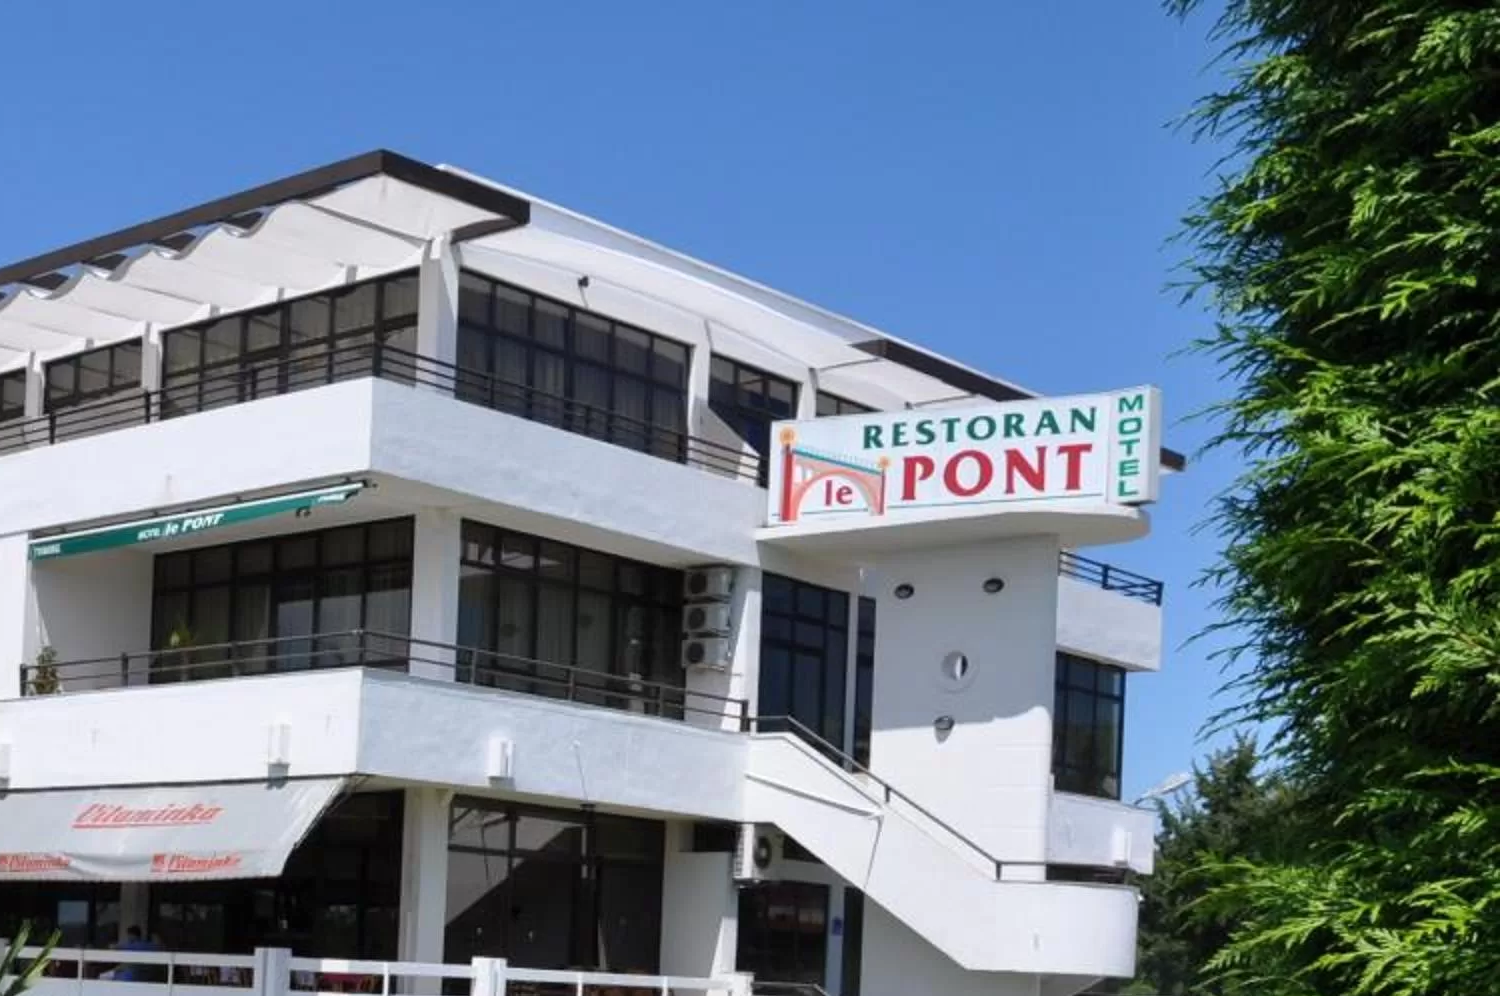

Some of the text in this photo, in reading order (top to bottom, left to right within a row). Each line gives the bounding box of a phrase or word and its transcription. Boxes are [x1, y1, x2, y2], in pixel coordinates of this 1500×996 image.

[862, 406, 1098, 450] RESTORAN
[1117, 394, 1144, 498] MOTEL
[824, 443, 1094, 506] le PONT
[181, 513, 224, 533] PONT
